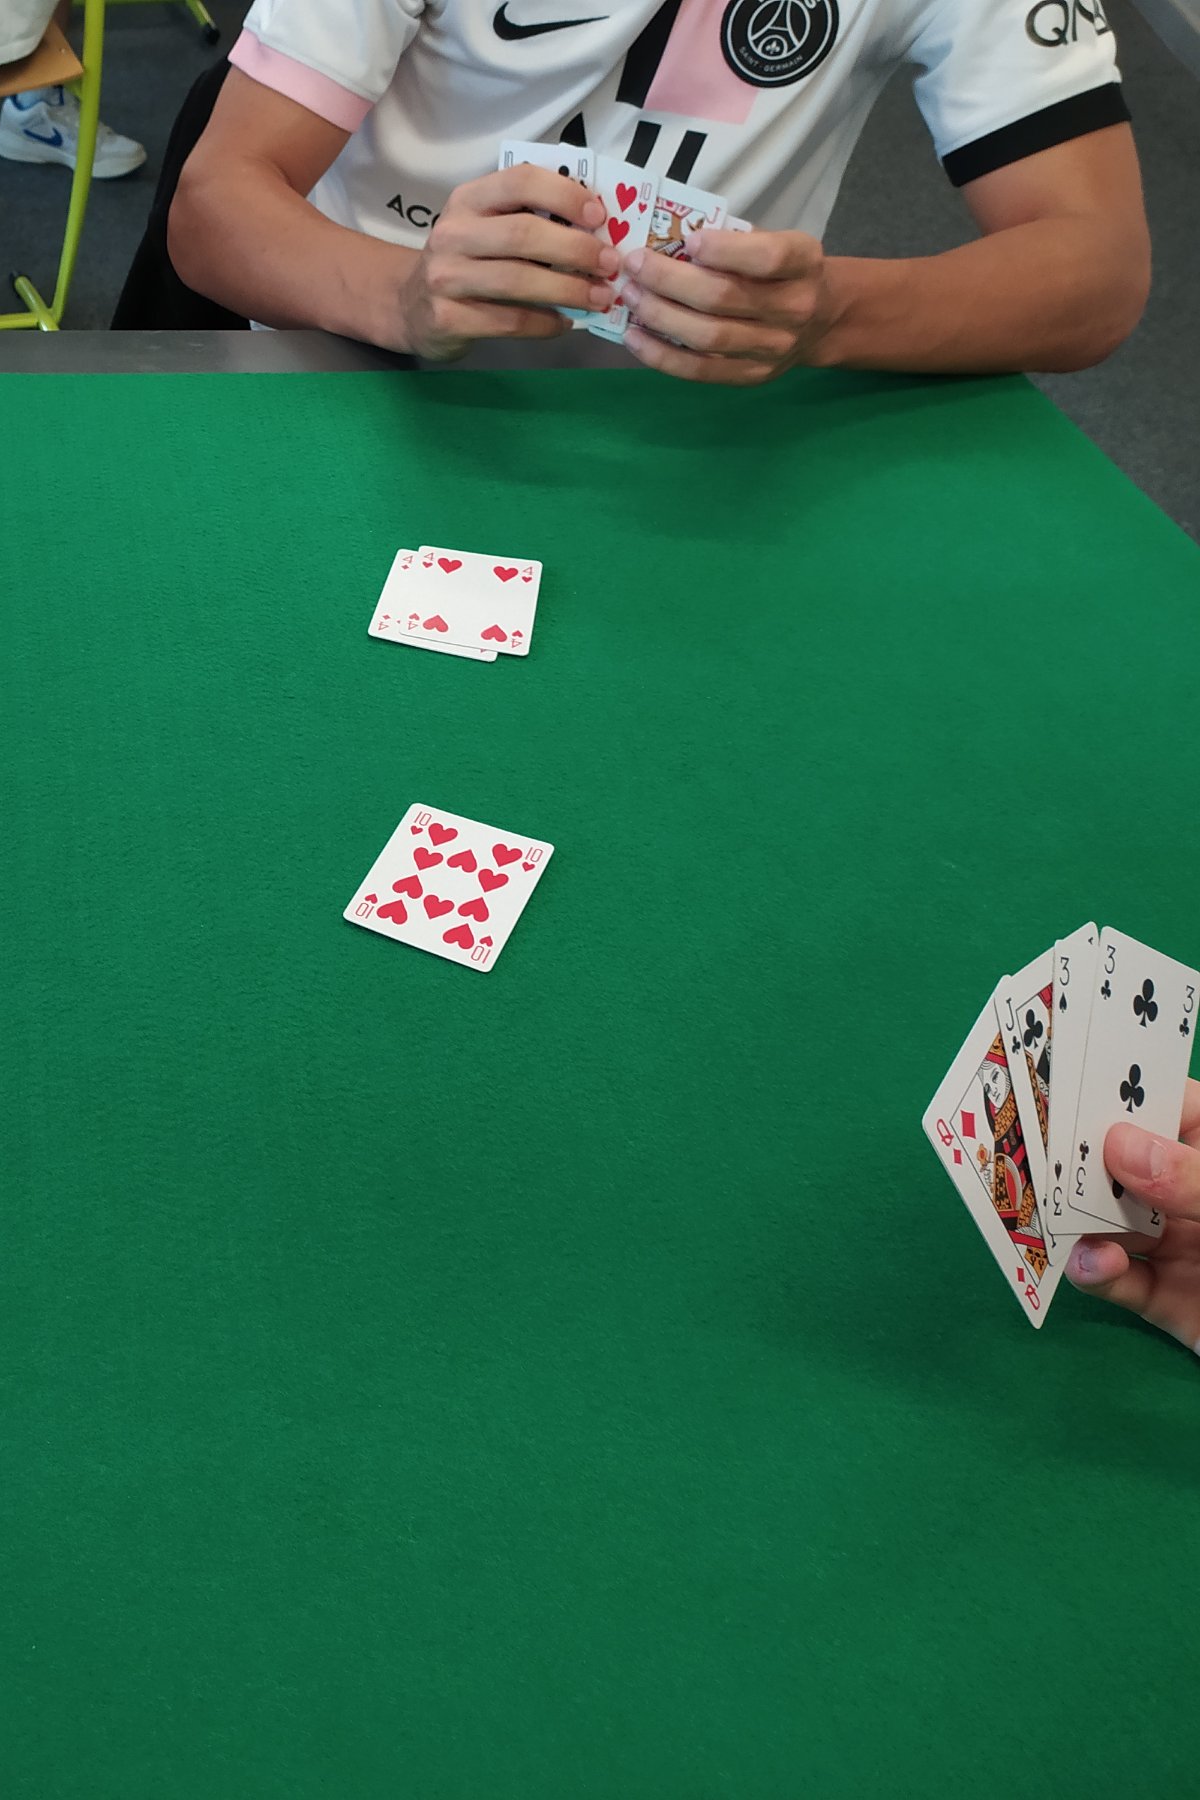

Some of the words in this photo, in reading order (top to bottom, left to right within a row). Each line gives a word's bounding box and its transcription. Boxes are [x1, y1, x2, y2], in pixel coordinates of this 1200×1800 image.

[578, 158, 588, 178] 10
[640, 181, 652, 201] 10
[386, 194, 441, 230] AC
[413, 811, 432, 827] 10
[525, 846, 544, 863] 10
[355, 902, 375, 919] 10
[470, 945, 491, 965] 10
[1104, 944, 1116, 975] 3
[1059, 956, 1070, 986] 3
[1183, 985, 1196, 1014] 3
[1005, 997, 1015, 1032] J
[936, 1118, 955, 1147] Q
[1075, 1166, 1087, 1197] 3
[1052, 1186, 1063, 1217] 3
[1024, 1284, 1041, 1311] Q
